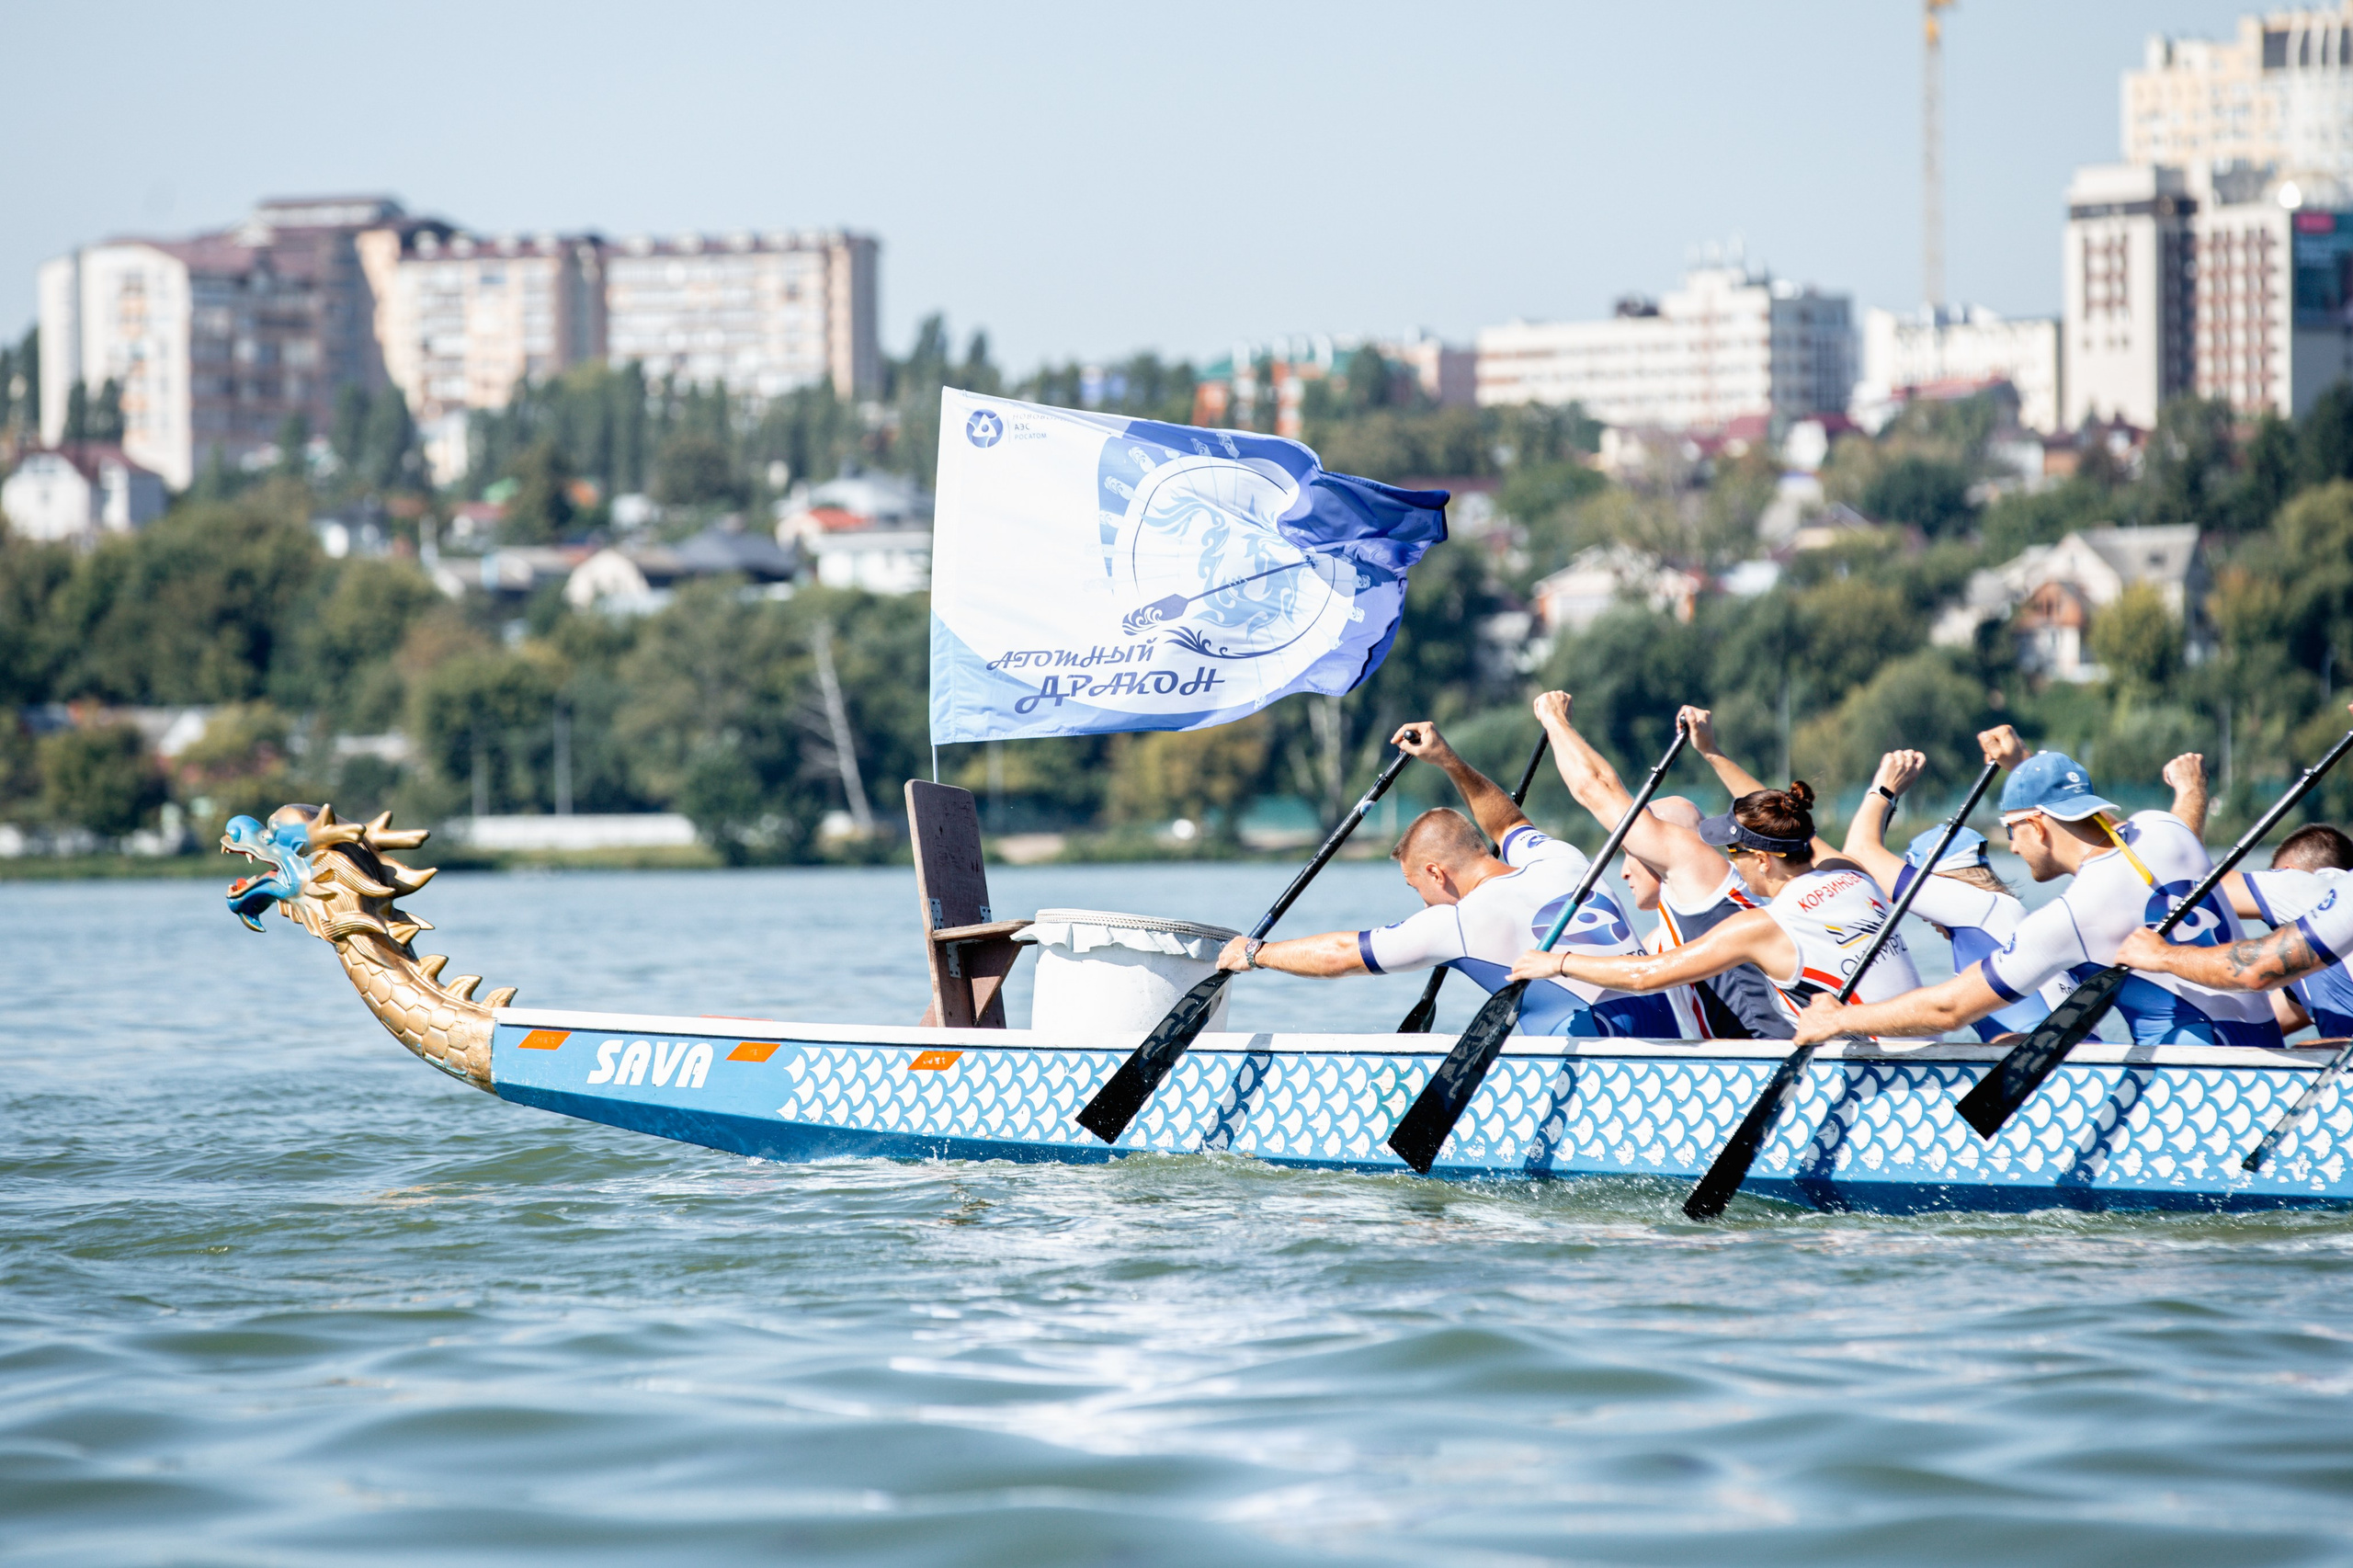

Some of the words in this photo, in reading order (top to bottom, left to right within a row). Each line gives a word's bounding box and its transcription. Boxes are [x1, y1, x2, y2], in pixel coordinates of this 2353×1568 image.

[1014, 423, 1030, 431] АЭС
[986, 637, 1158, 671] АТОМНЫЙ
[1014, 666, 1225, 714] ДРАКОН
[586, 1040, 714, 1089] SAVA
